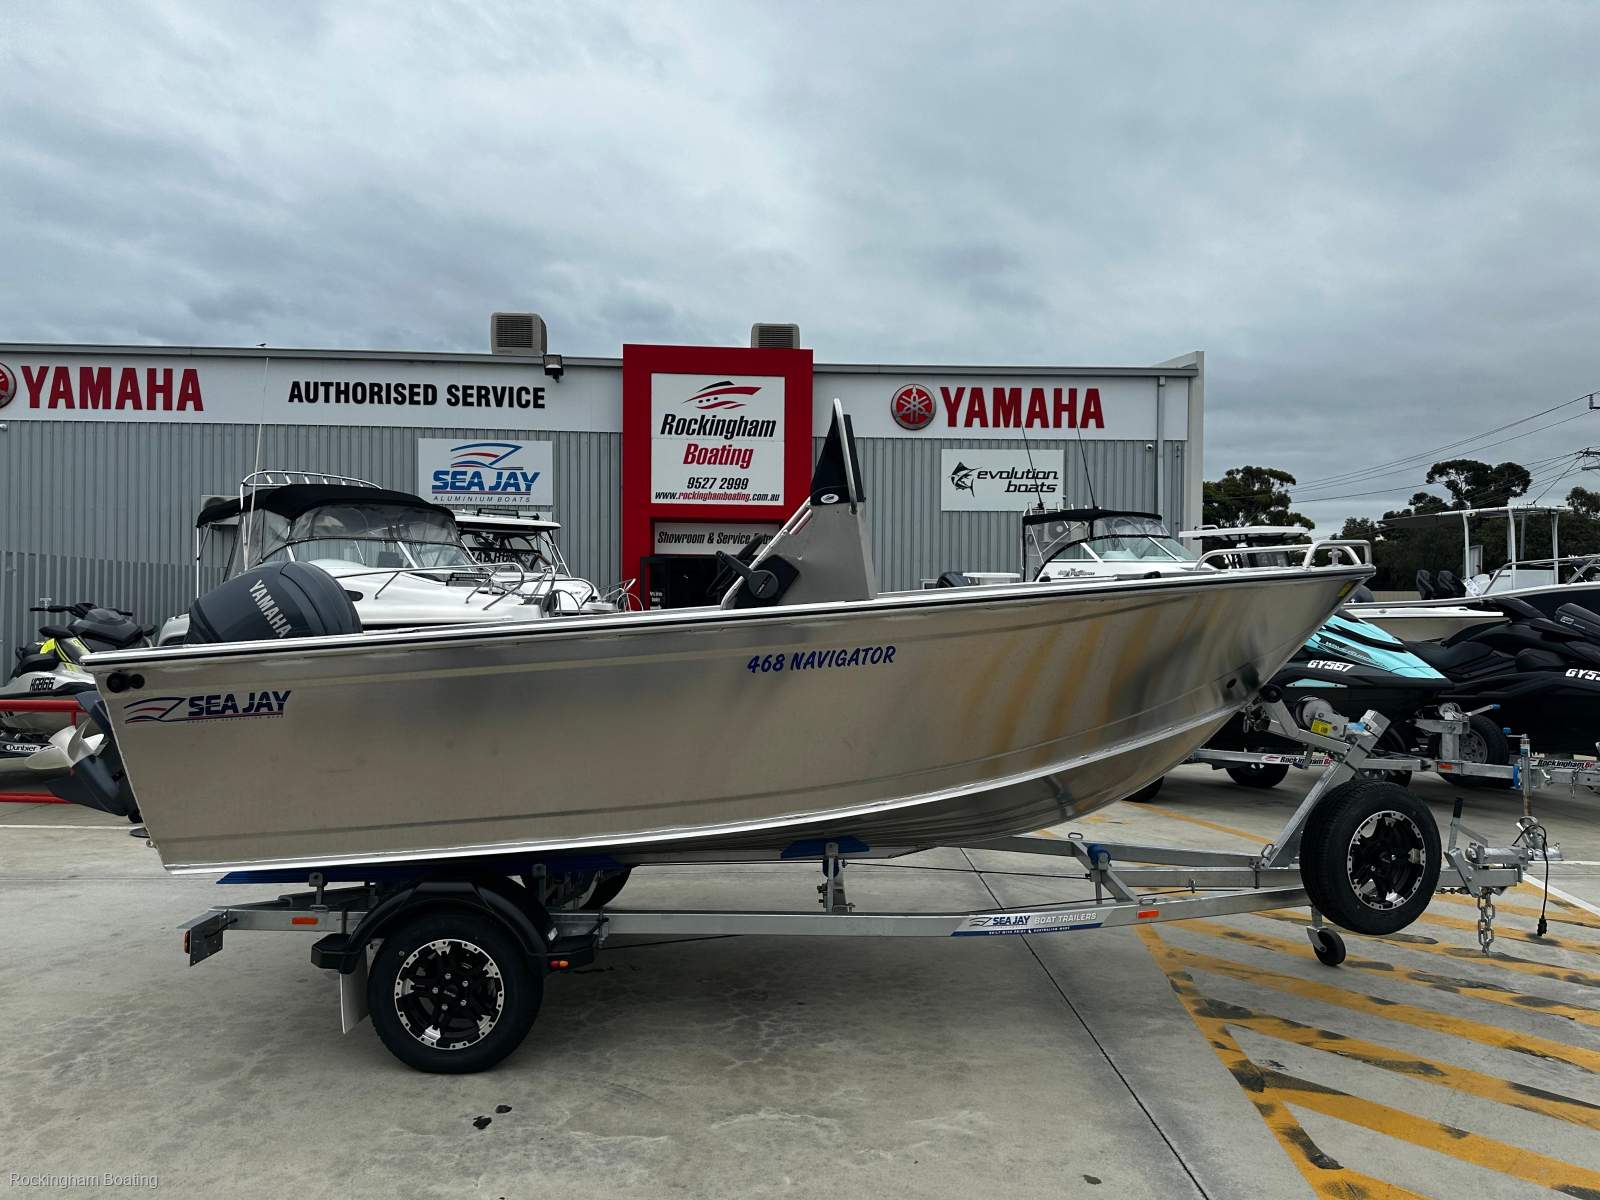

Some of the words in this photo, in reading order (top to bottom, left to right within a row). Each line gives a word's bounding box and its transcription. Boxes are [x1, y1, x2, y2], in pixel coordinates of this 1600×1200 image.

[20, 365, 204, 412] YAMAHA
[287, 380, 438, 406] AUTHORISED
[446, 384, 546, 409] SERVICE
[939, 386, 1105, 429] YAMAHA
[660, 413, 777, 440] Rockingham
[682, 443, 754, 470] Boating
[431, 470, 485, 491] SEA
[488, 471, 541, 492] JAY
[686, 476, 717, 490] 9527
[718, 477, 750, 490] 2999
[976, 466, 1059, 480] evolution
[654, 491, 781, 503] www.rockinghamboating.com.au
[1004, 479, 1058, 493] boats
[657, 531, 705, 544] Showroom
[706, 531, 715, 544] &
[716, 532, 751, 545] Service
[249, 579, 292, 639] YAMAHA
[747, 653, 786, 674] 468
[790, 645, 897, 671] NAVIGATOR
[1306, 658, 1355, 673] GY567
[188, 693, 240, 717] SEA
[241, 690, 292, 714] JAY
[992, 916, 1012, 926] SEA
[1012, 915, 1031, 926] JAY
[1034, 916, 1056, 925] BOAT
[1058, 912, 1097, 923] TRAILERS
